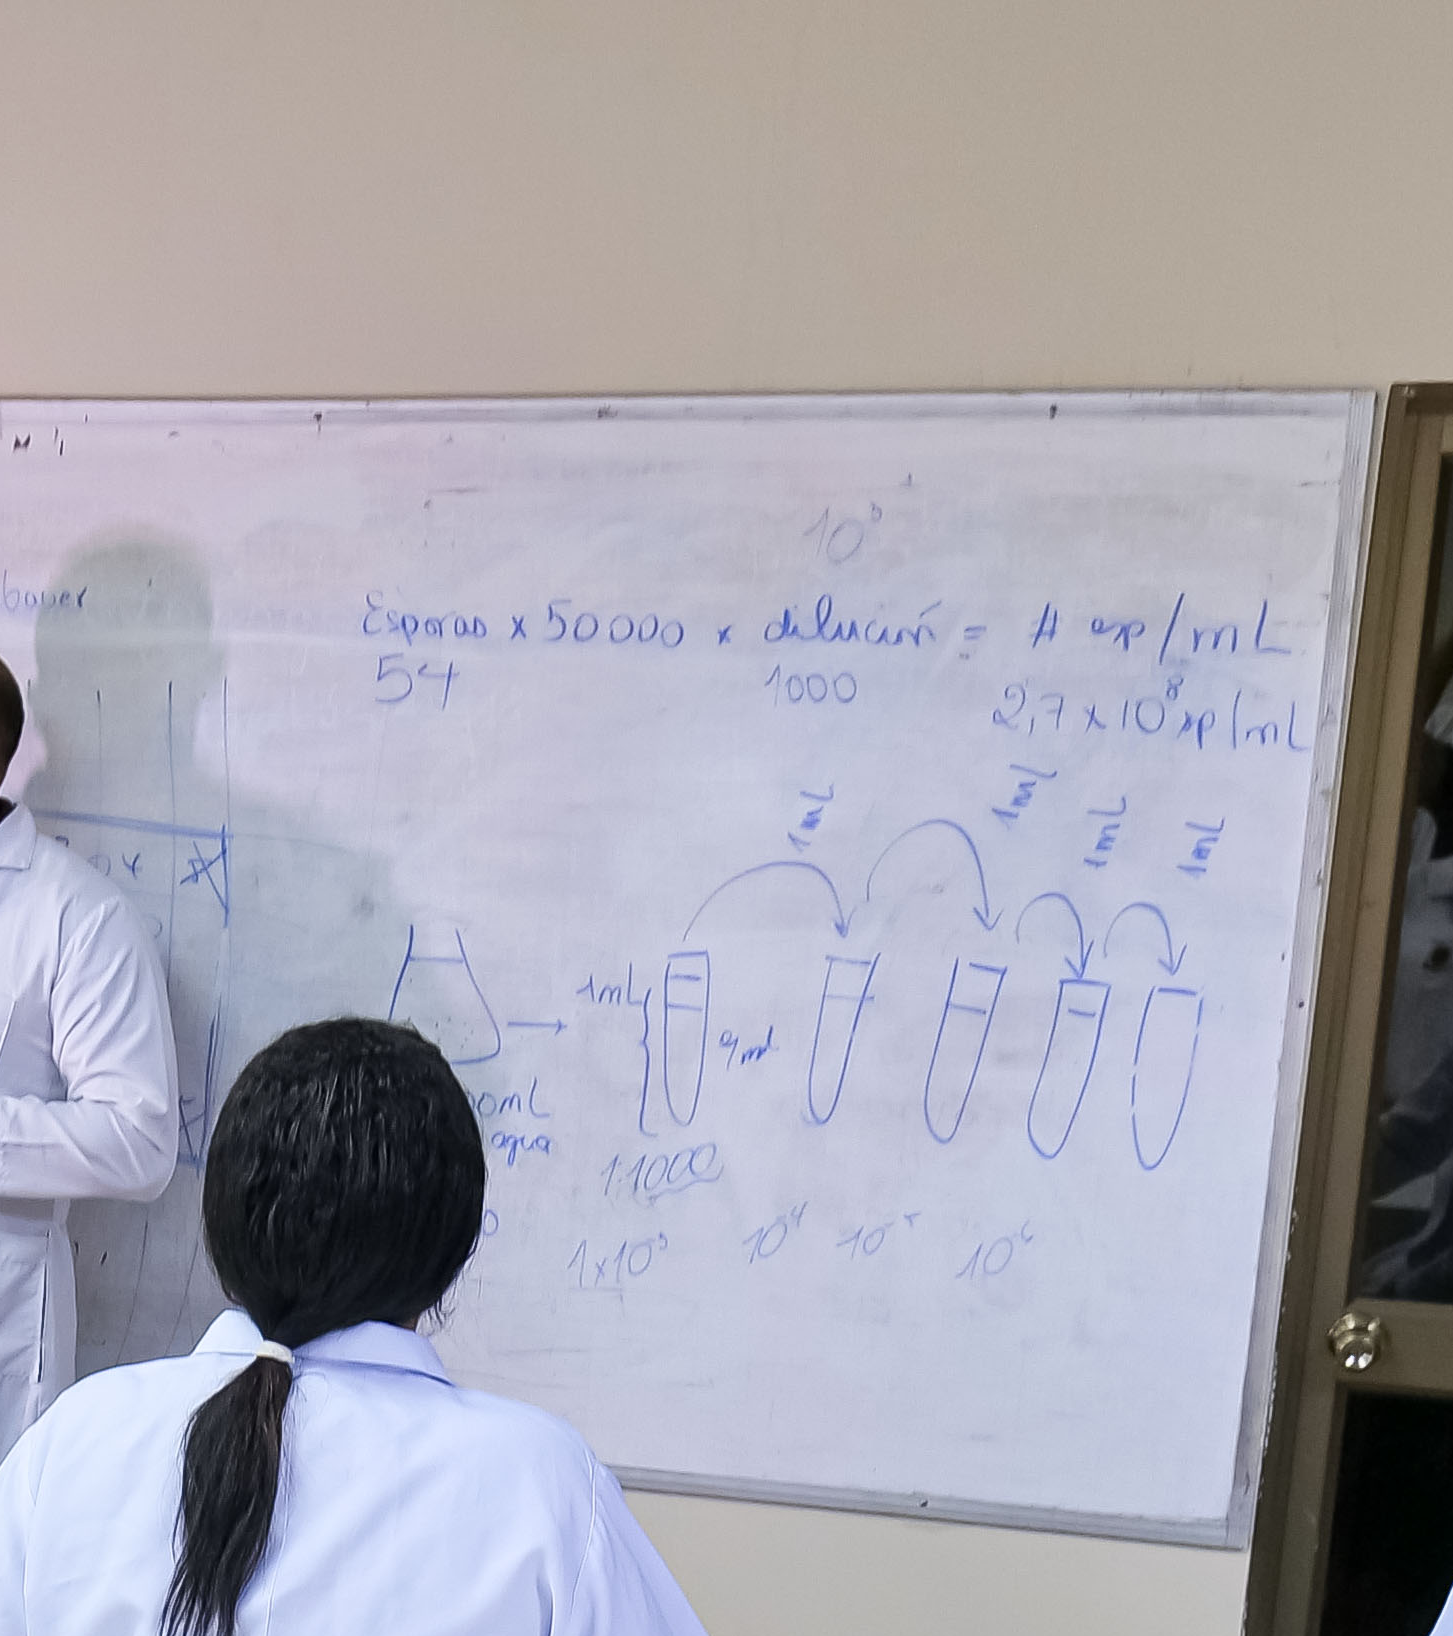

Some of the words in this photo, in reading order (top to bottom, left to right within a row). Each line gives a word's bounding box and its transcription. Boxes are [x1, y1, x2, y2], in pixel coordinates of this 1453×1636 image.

[374, 652, 460, 712] 54
[764, 663, 858, 707] 1000
[491, 1130, 551, 1167] agua
